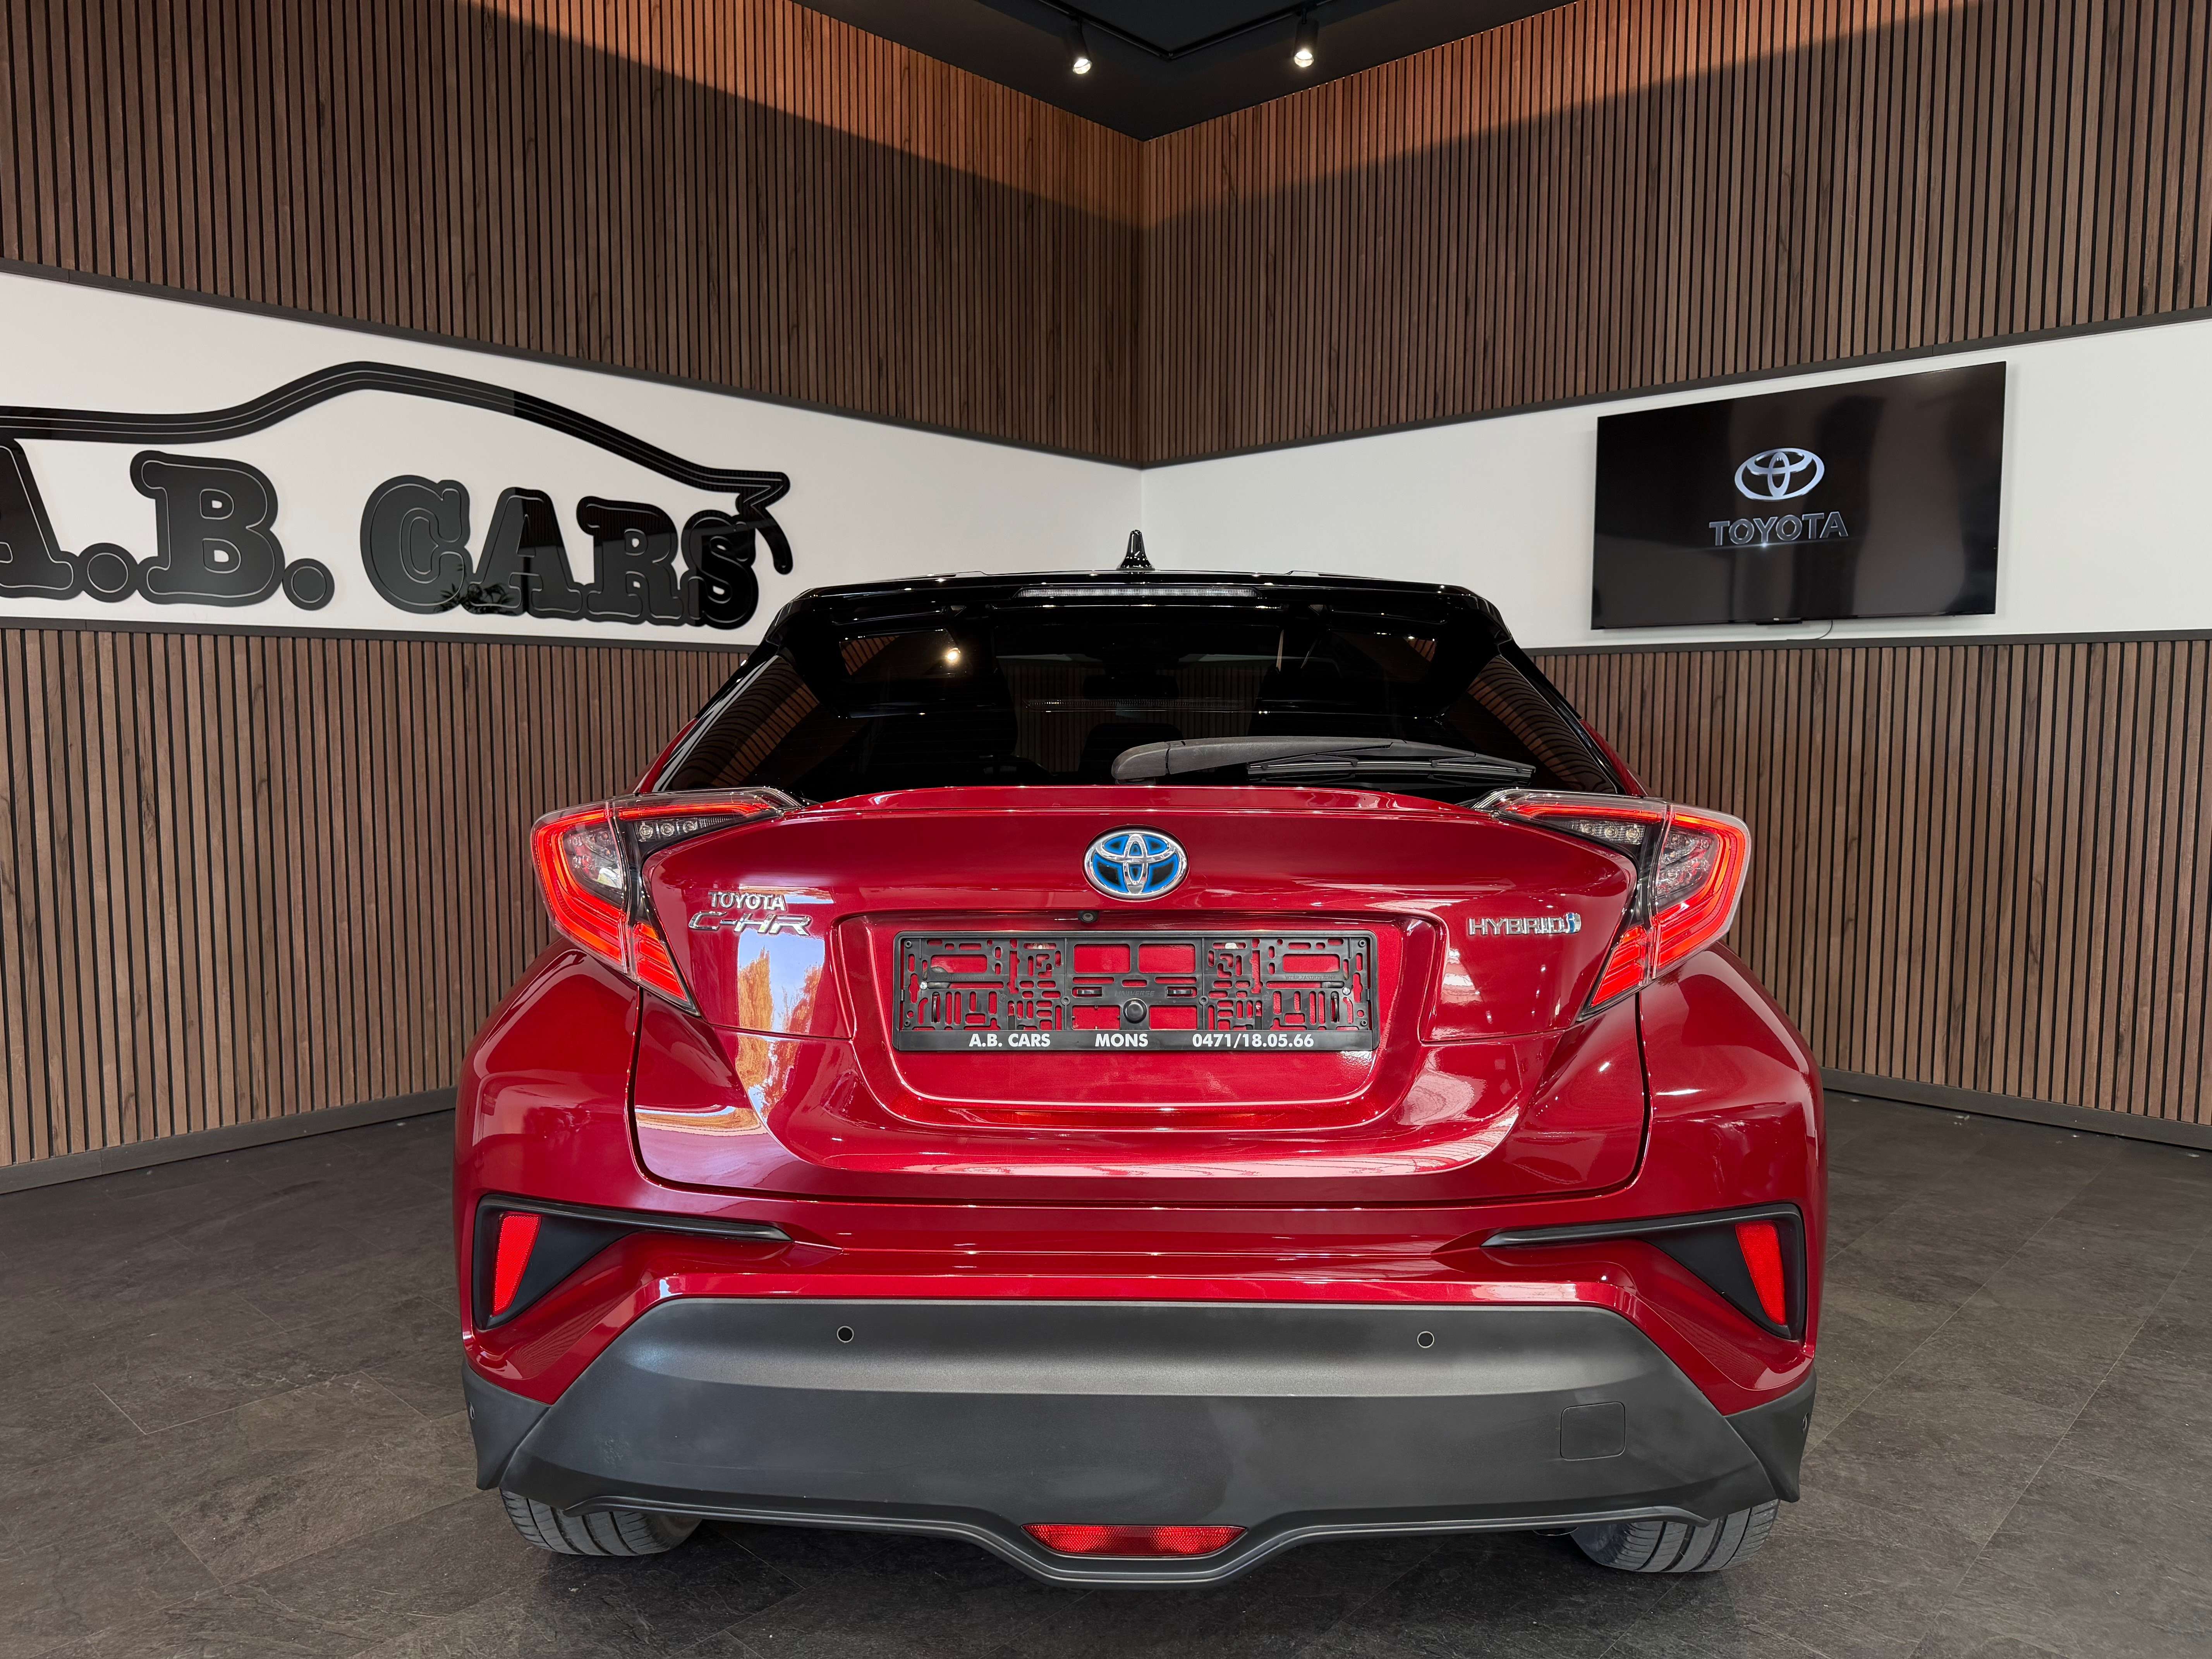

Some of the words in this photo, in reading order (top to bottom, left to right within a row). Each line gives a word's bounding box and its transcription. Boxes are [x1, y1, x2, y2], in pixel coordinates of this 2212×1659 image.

[1709, 511, 1848, 546] TOYOTA
[360, 475, 758, 630] CARS
[708, 891, 787, 911] TOYOTA
[688, 911, 812, 936] C-HR
[1468, 917, 1564, 935] HYBRID
[969, 1033, 1003, 1047] A.B.
[1008, 1033, 1051, 1047] CARS
[1095, 1033, 1149, 1047] MONS
[1192, 1033, 1314, 1049] 0471/18.05.66
